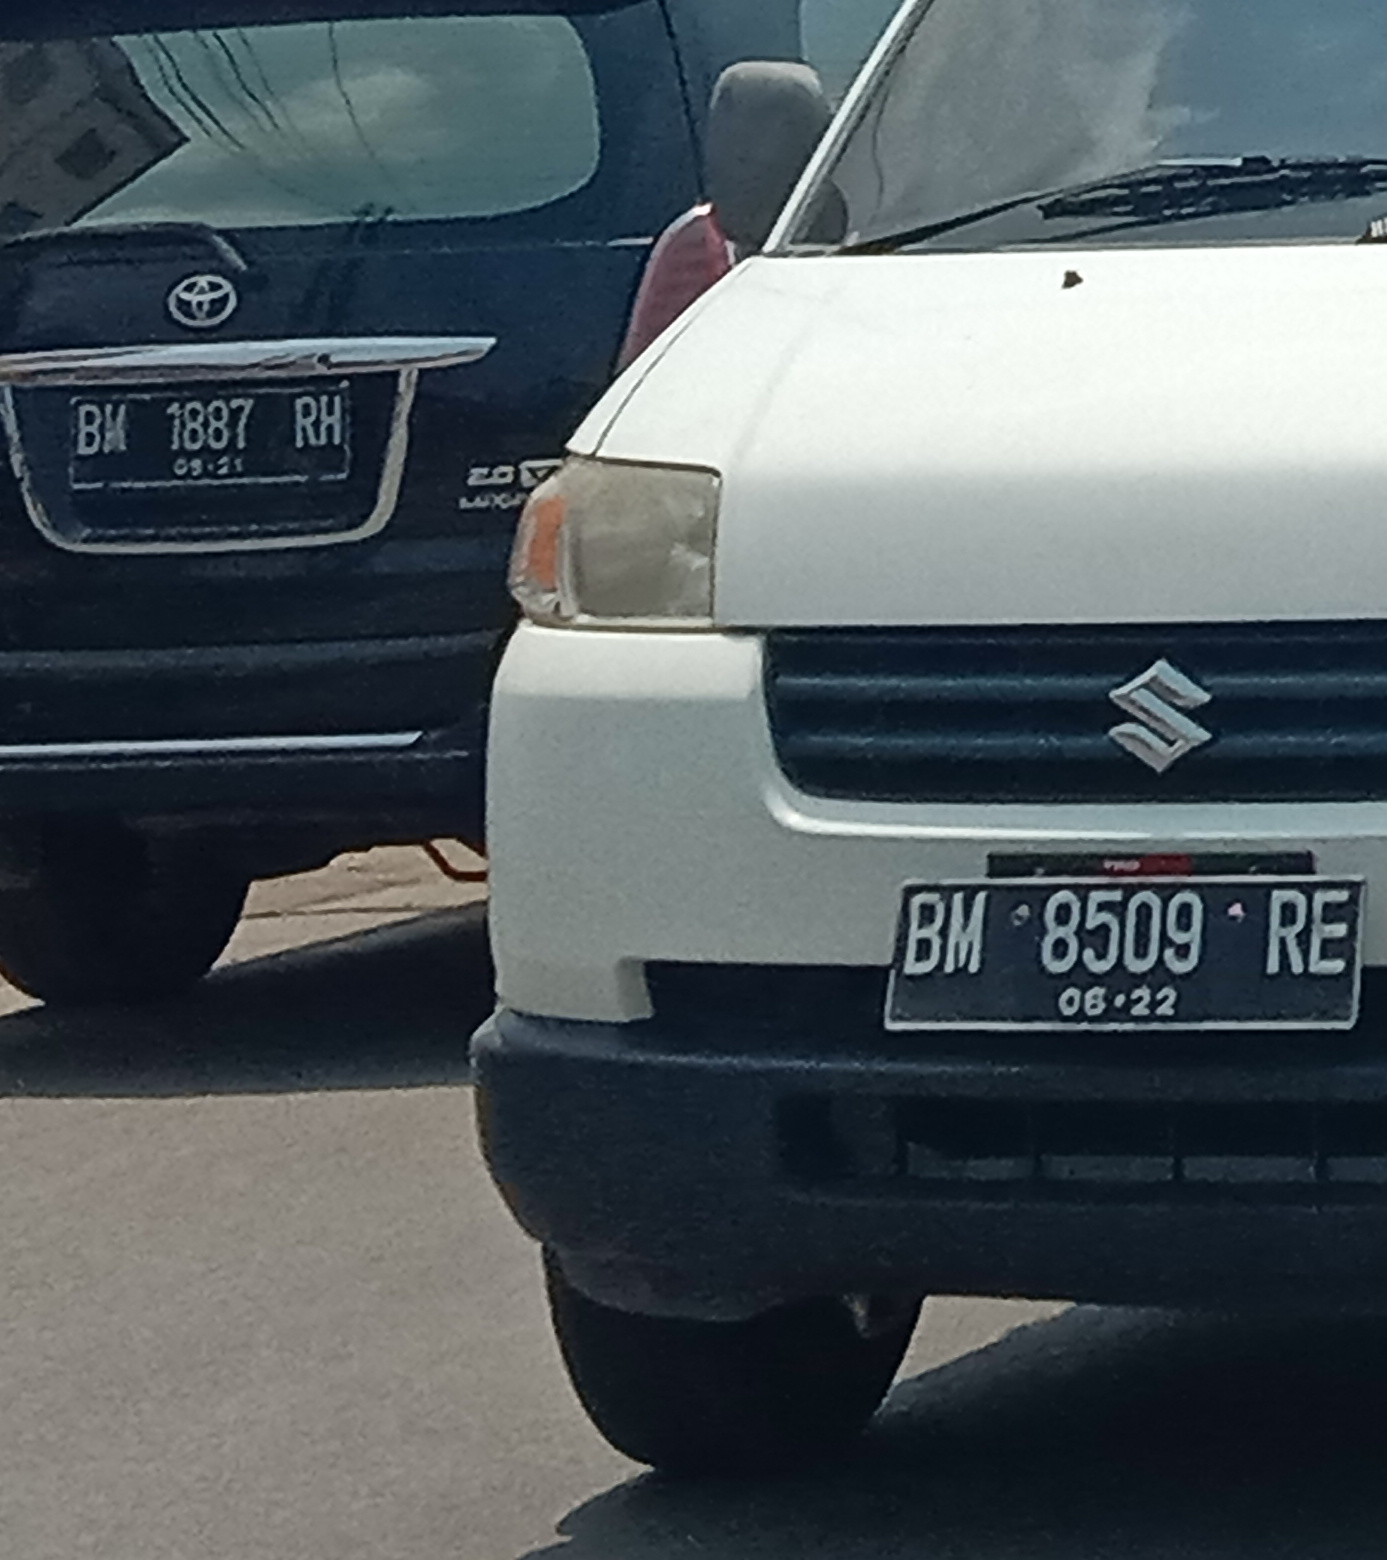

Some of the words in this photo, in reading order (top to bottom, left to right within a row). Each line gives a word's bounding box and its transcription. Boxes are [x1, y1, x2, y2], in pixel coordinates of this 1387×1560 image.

[76, 403, 127, 456] BM
[166, 398, 254, 452] 1887
[294, 394, 343, 449] RH
[902, 890, 989, 975] BM
[1040, 889, 1203, 975] 8509
[1265, 889, 1350, 975] RE
